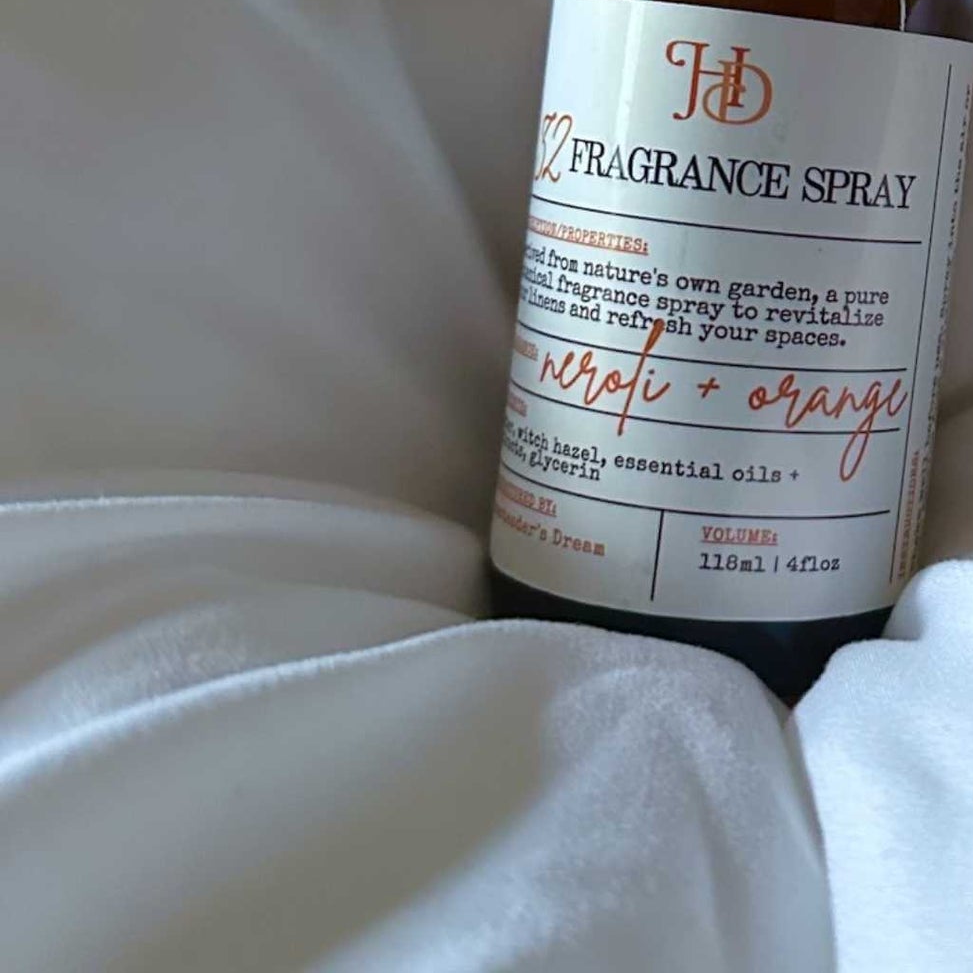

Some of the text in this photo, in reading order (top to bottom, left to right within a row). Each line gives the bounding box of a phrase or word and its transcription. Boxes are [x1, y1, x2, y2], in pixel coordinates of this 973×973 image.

[568, 137, 790, 200] FRAGRANCE
[801, 167, 917, 209] SPRAY
[548, 249, 579, 273] from
[583, 261, 669, 288] nature's
[676, 277, 720, 295] own
[727, 281, 819, 305] garden,
[826, 289, 839, 304] a
[844, 290, 889, 307] pure
[557, 274, 650, 308] fragrance
[656, 296, 725, 321] spray
[732, 299, 758, 320] to
[765, 305, 885, 327] revitalize
[528, 290, 566, 315] linens
[569, 303, 601, 322] and
[607, 310, 692, 335] refrsh
[698, 324, 758, 343] your
[764, 328, 847, 349] spaces.
[540, 318, 671, 437] neroli
[748, 373, 908, 482] orange
[517, 426, 549, 451] witch
[553, 437, 607, 468] hazel,
[614, 455, 724, 481] essential
[732, 465, 782, 483] oils
[529, 449, 601, 482] glycerin
[552, 528, 606, 557] Dream
[699, 552, 766, 573] 118ml
[701, 525, 779, 545] VOLUME:
